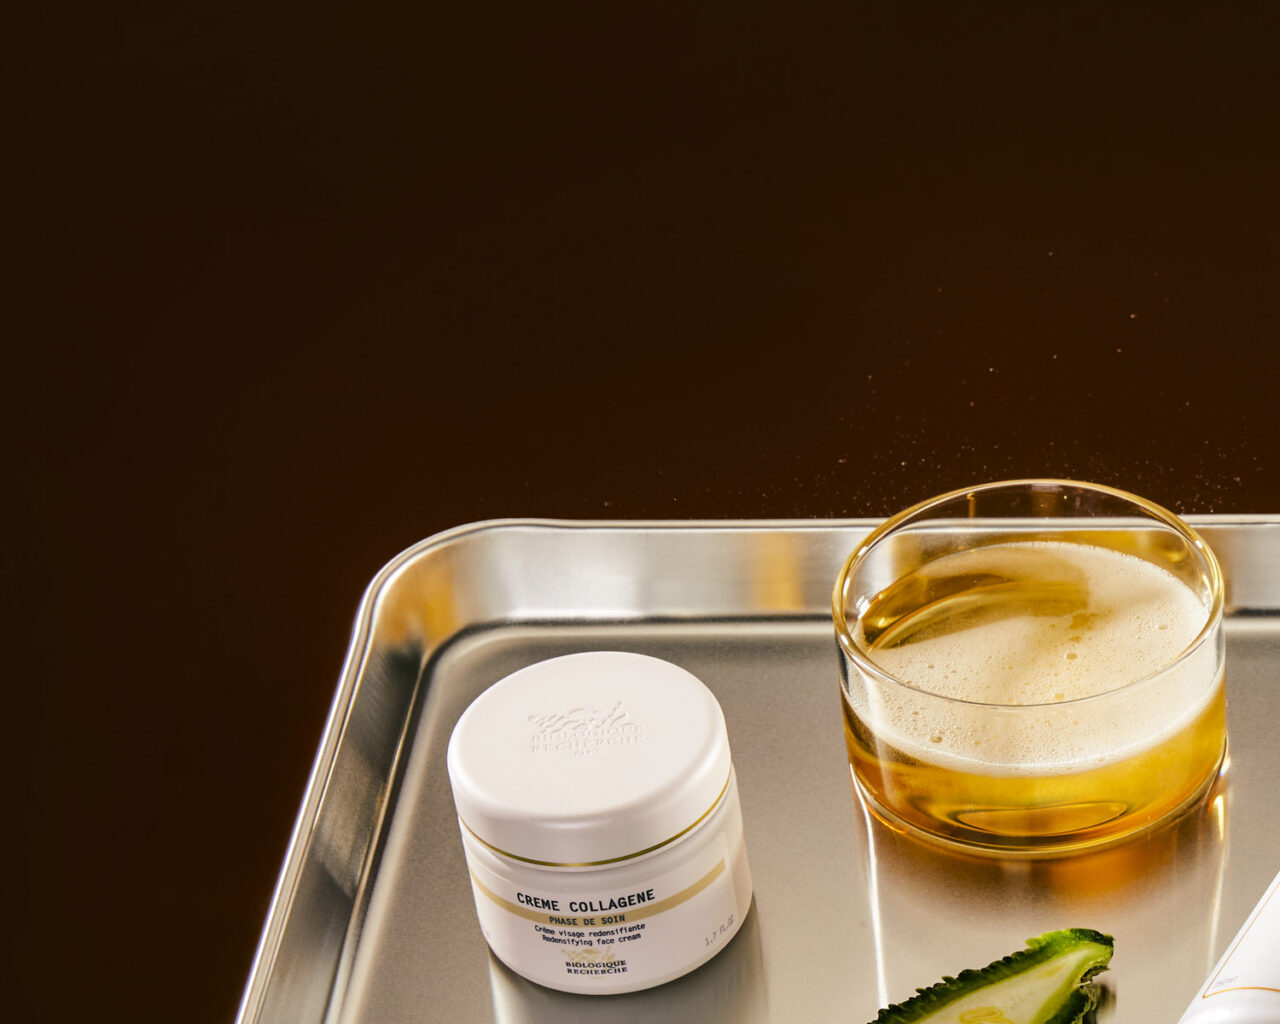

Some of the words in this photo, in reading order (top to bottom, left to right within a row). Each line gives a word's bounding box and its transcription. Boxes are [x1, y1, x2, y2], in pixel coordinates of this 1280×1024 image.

[517, 892, 560, 912] CREME
[569, 889, 655, 913] COLLAGENE
[550, 916, 578, 926] PHASE
[584, 918, 595, 926] DE
[602, 915, 625, 924] SOIN
[534, 925, 555, 935] Crème
[559, 930, 585, 938] visage
[589, 923, 645, 937] redensifiante
[542, 934, 593, 946] Redensifying
[618, 933, 641, 943] cream
[705, 931, 717, 946] 1.7
[566, 960, 627, 969] BIOLOGIQUE
[567, 967, 628, 975] RECHERCHE
